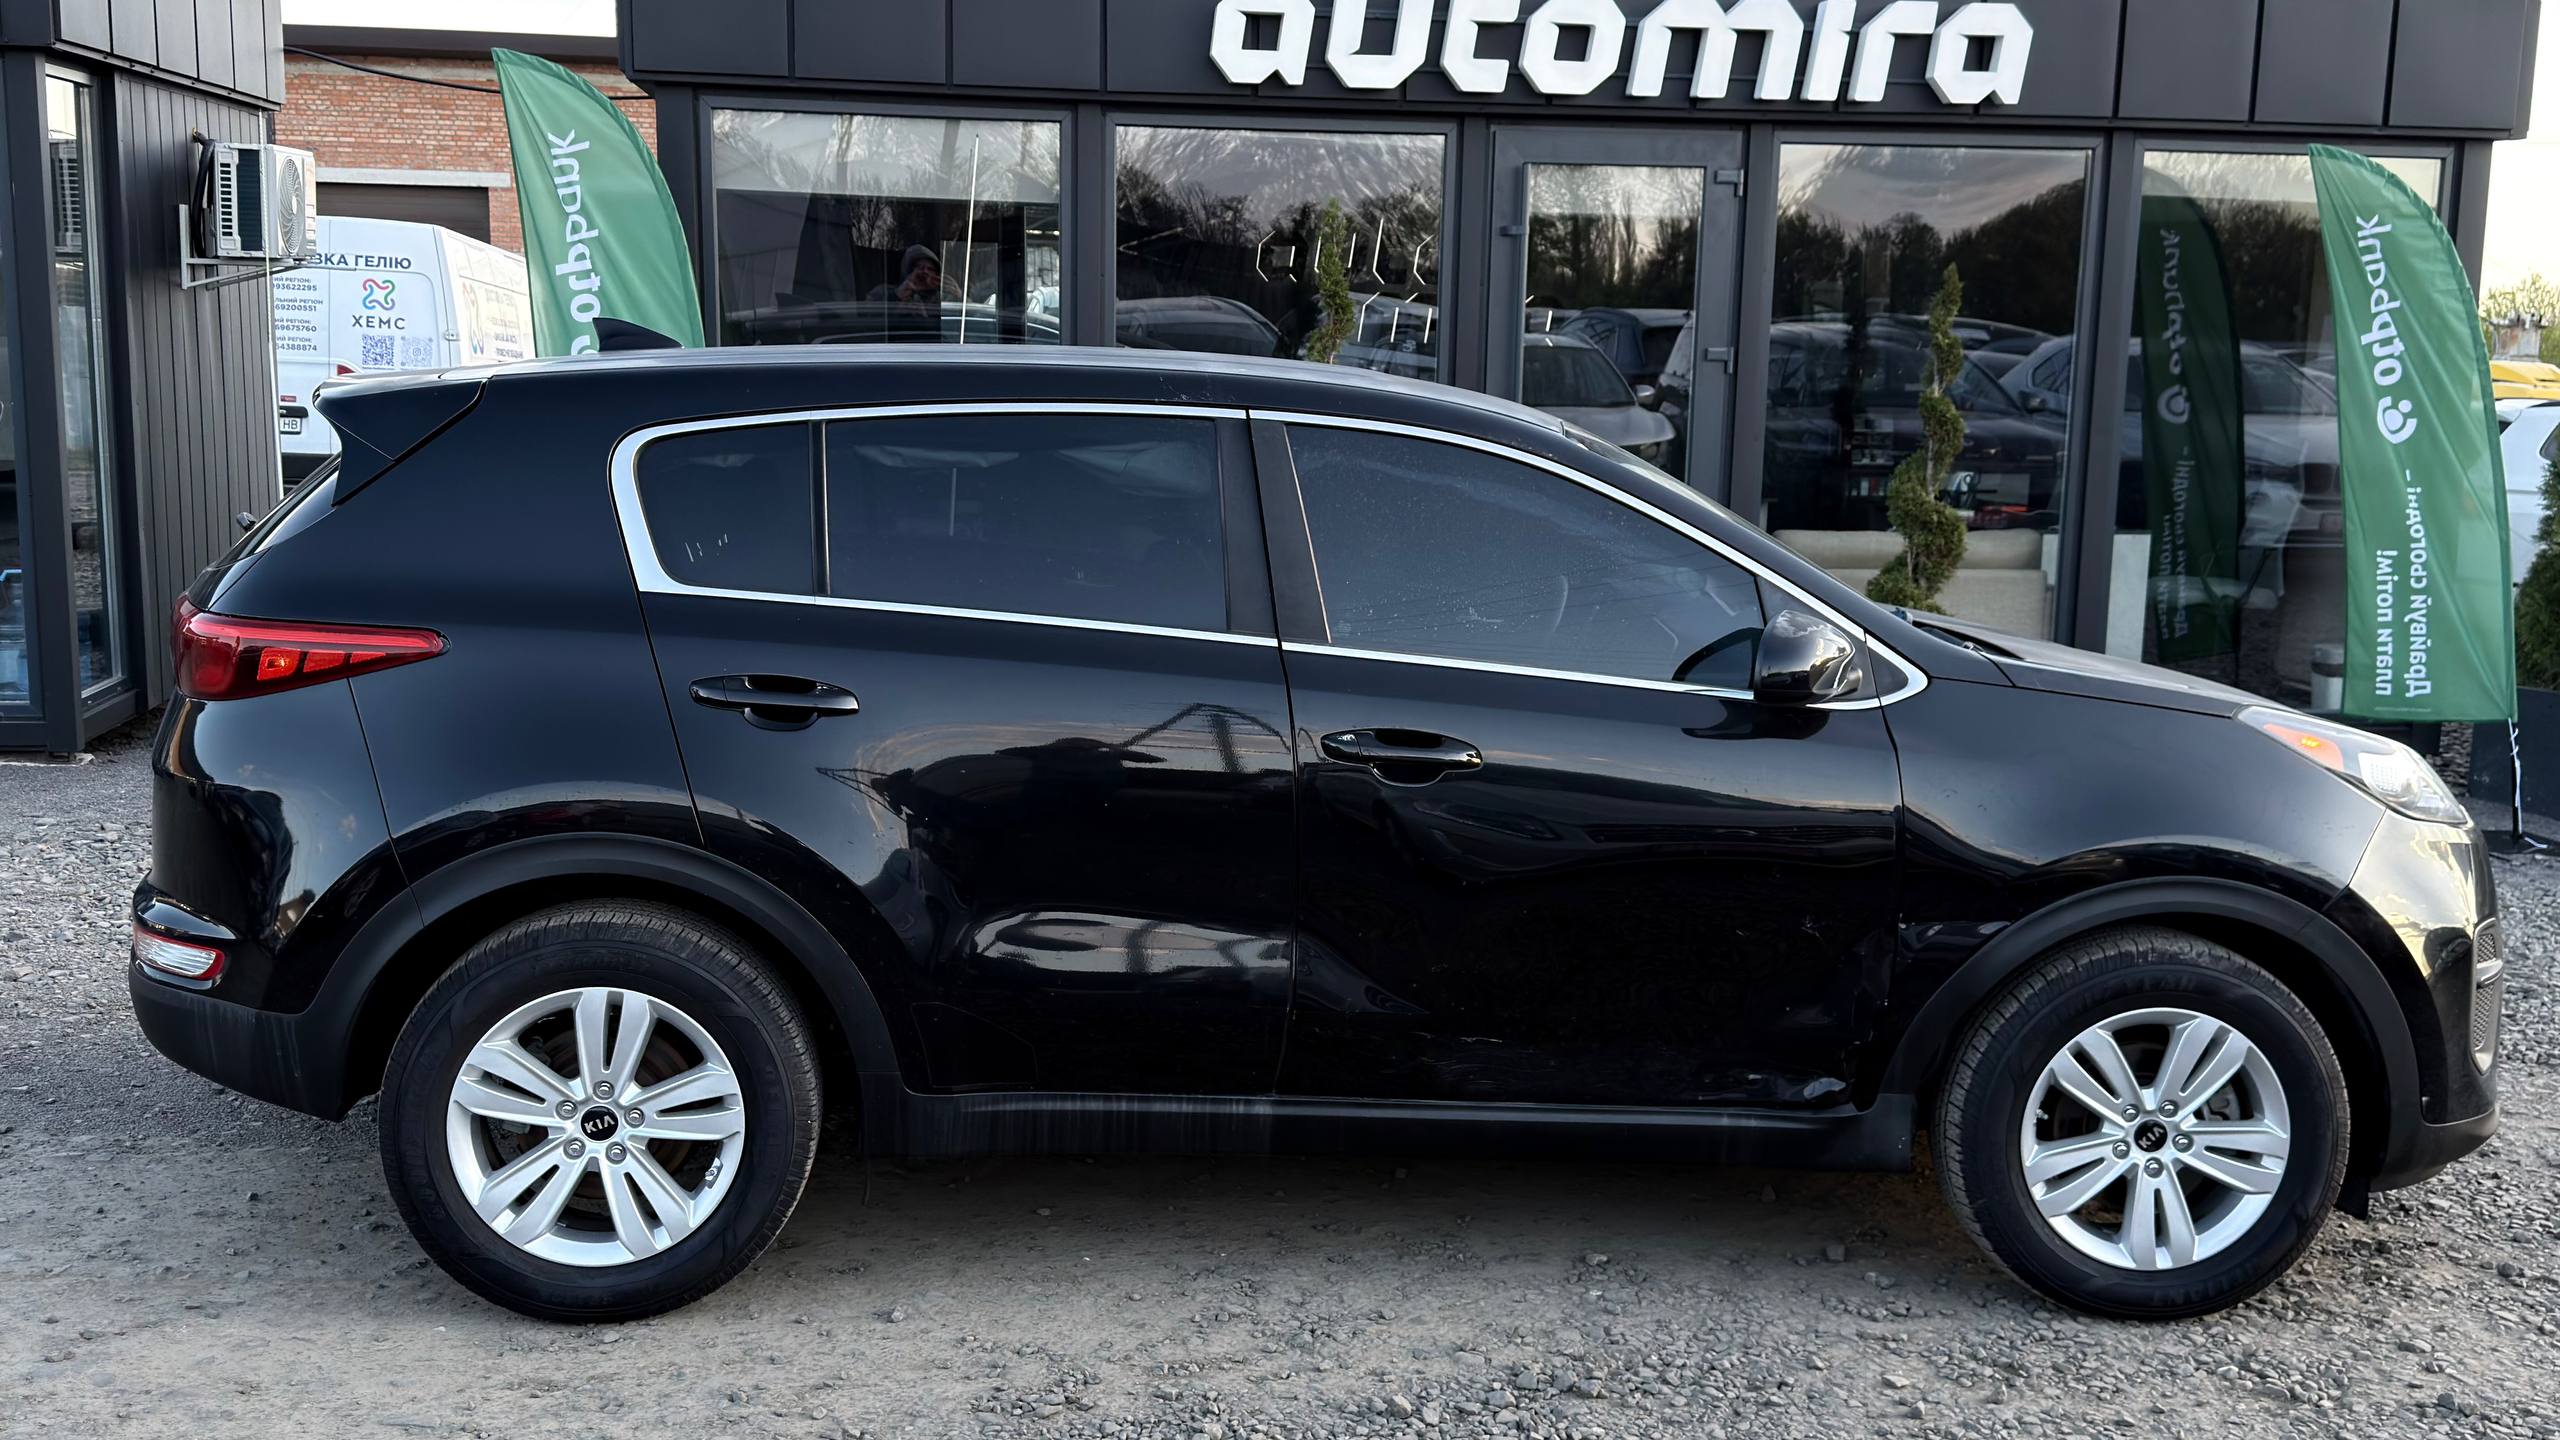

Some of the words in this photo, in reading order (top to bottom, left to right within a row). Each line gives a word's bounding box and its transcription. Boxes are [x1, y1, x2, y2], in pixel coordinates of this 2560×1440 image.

[1209, 0, 2034, 105] automira
[355, 255, 412, 269] ГЕЛІЮ
[584, 1115, 615, 1134] KIA
[2138, 1126, 2164, 1149] KIA
